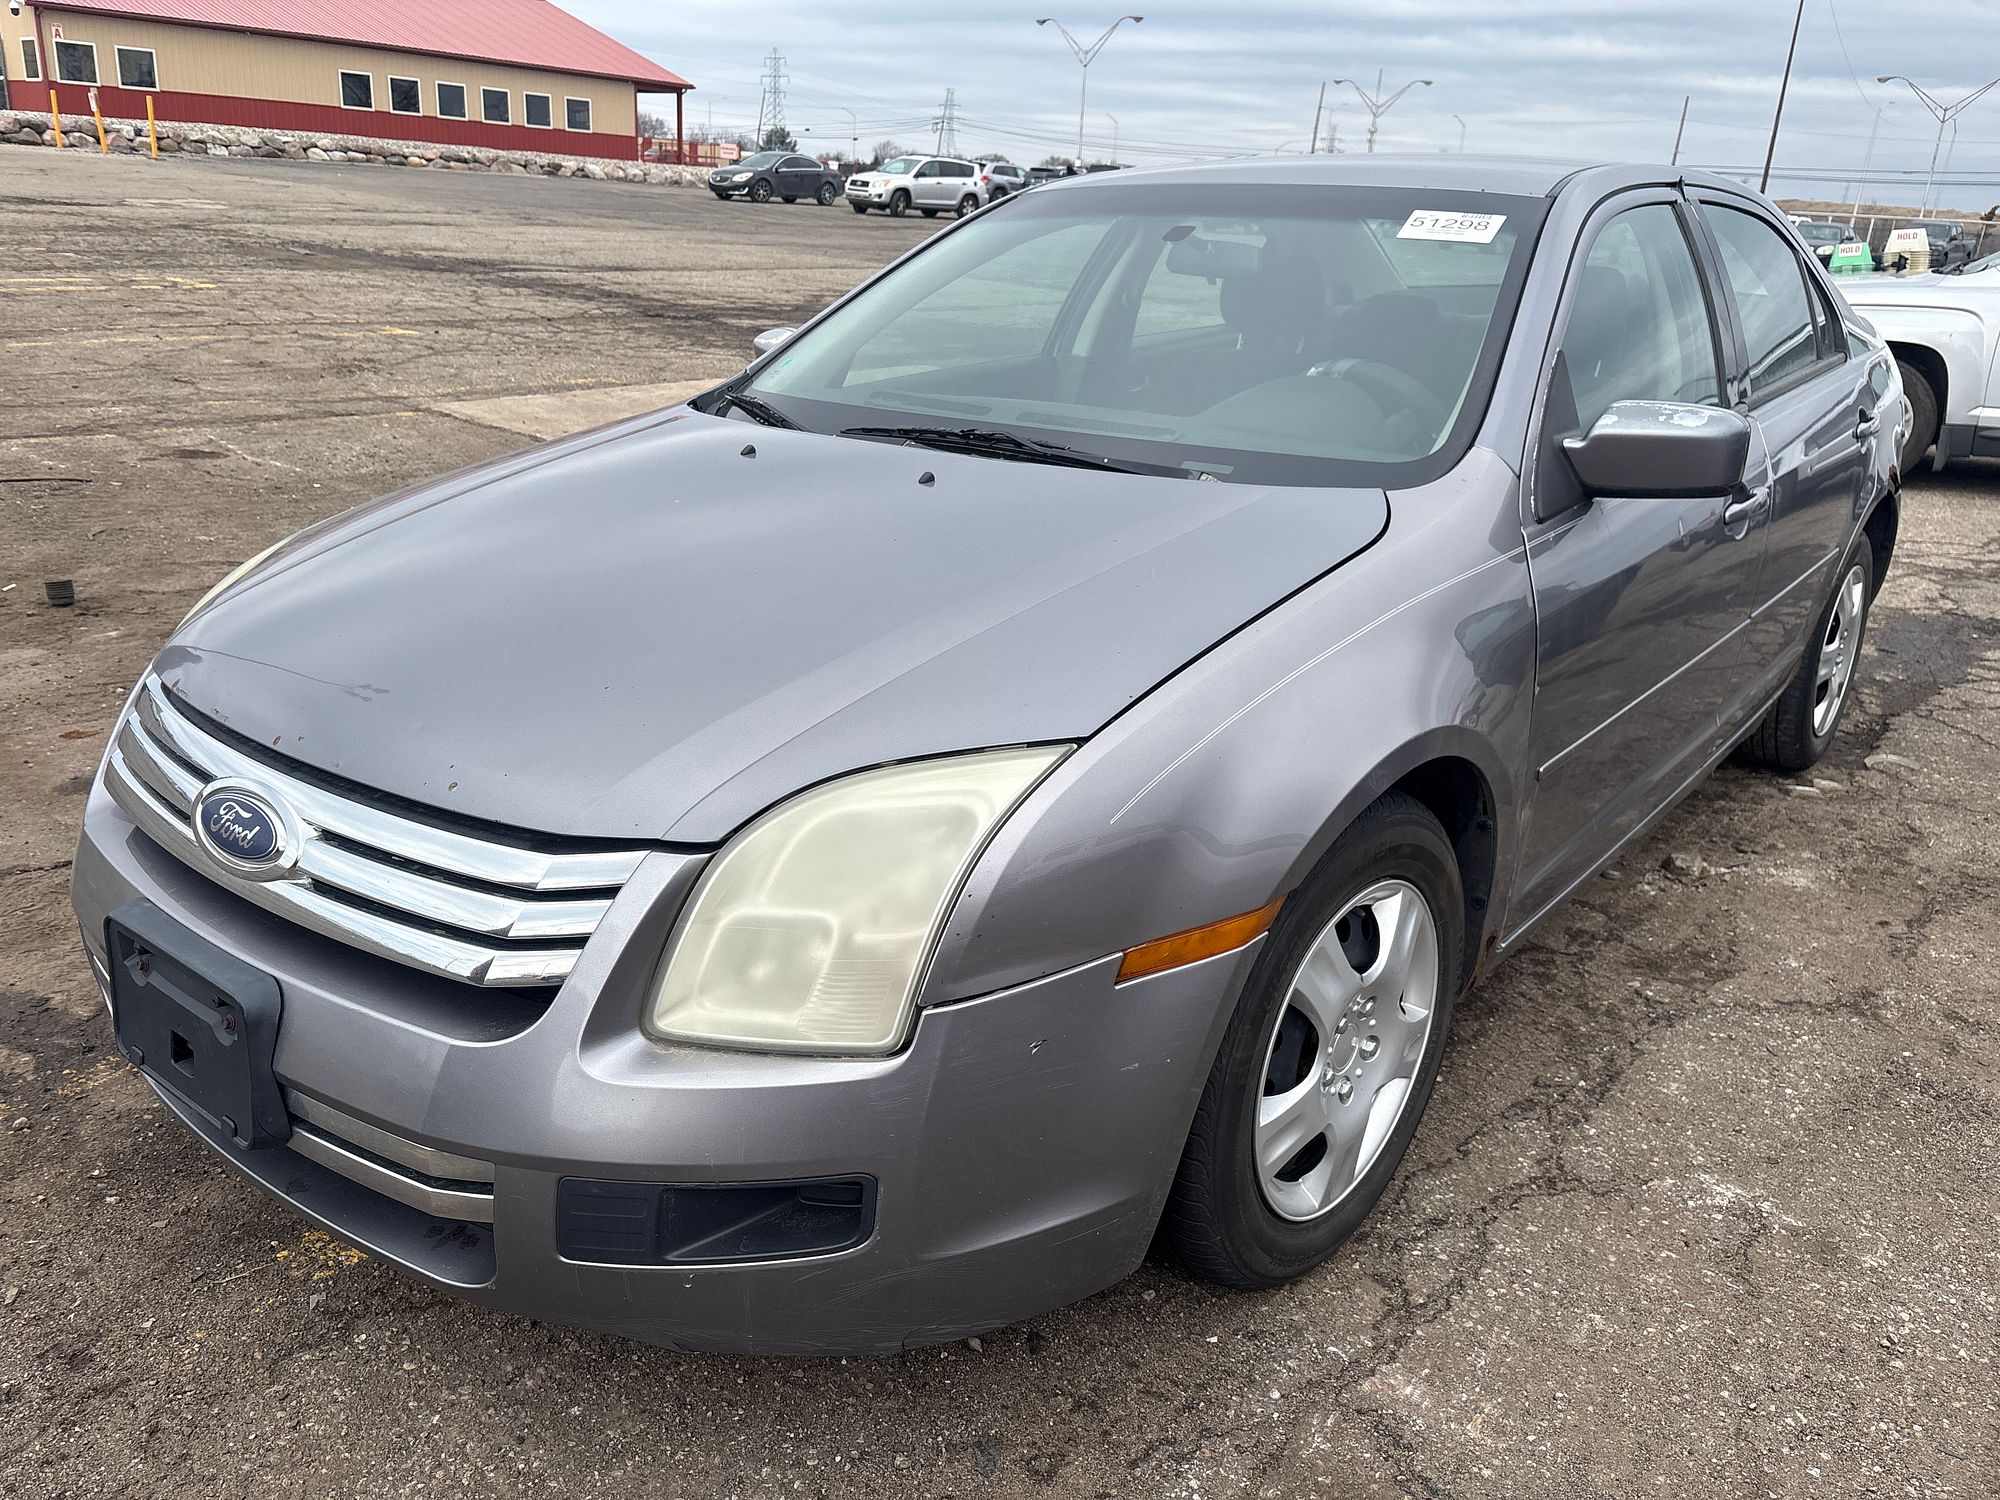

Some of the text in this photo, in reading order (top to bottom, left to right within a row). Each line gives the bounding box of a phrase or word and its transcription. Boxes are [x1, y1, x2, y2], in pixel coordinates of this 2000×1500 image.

[1410, 216, 1490, 231] 51298
[1897, 231, 1918, 240] HOLD
[1840, 245, 1860, 254] HOLD
[210, 801, 261, 849] Ford
